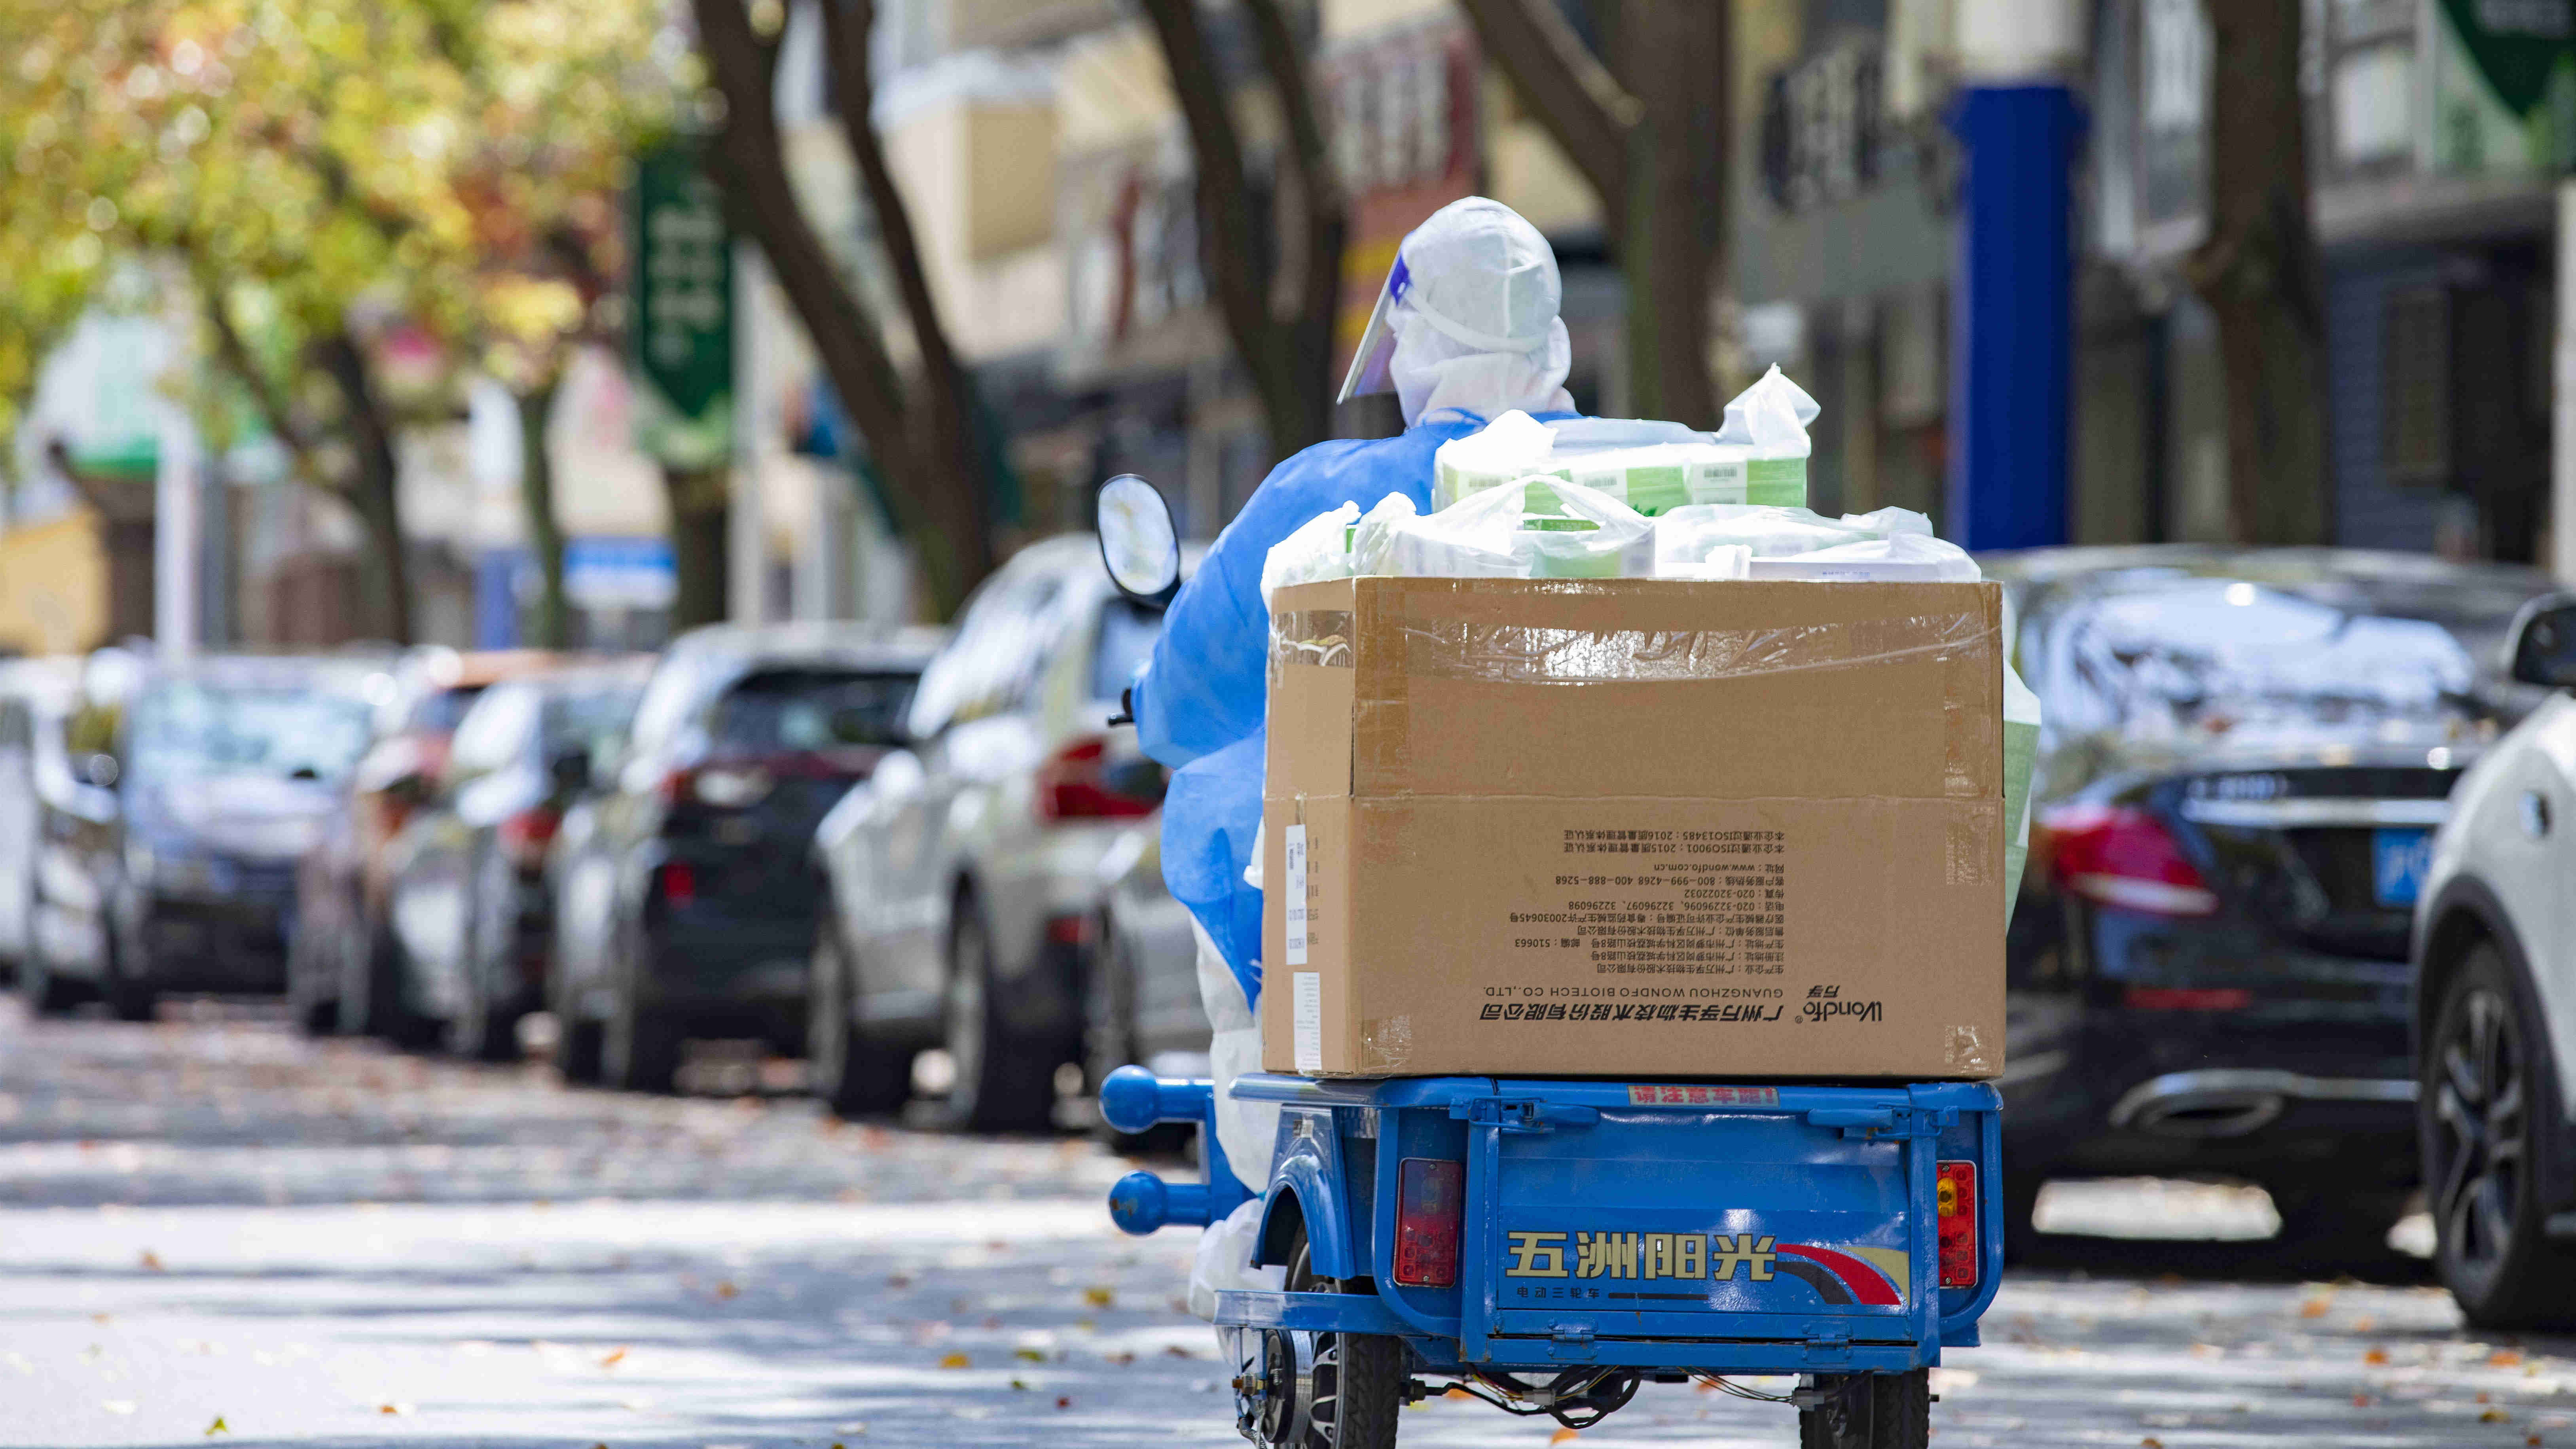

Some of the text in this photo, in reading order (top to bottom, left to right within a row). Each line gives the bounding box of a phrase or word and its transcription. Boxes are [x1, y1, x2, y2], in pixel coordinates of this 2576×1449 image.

[1550, 987, 1615, 998] BIOTECH
[1619, 987, 1685, 998] WONDFO
[1689, 987, 1784, 999] GUANGZHOU
[1806, 985, 1841, 999] 万孚
[1479, 1003, 1784, 1022] 广州万孚生物技术股份有限公司
[1505, 1230, 1777, 1282] 五洲阳光
